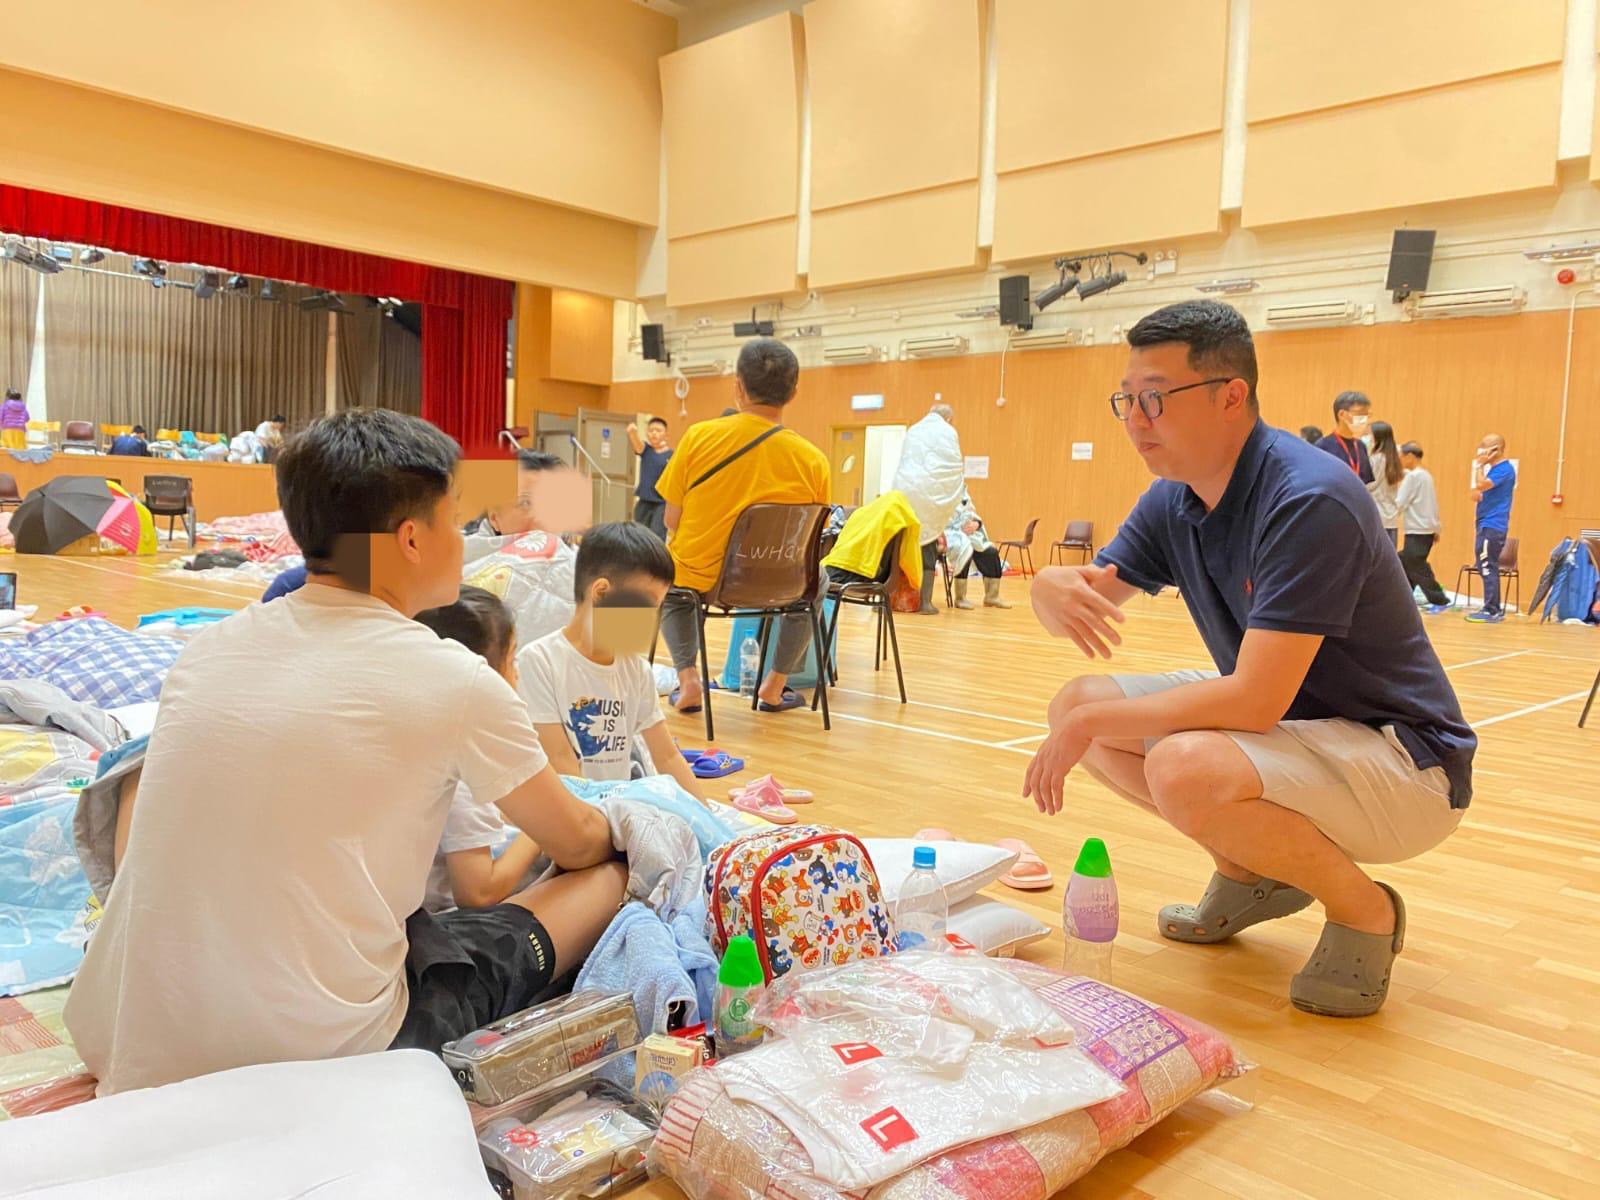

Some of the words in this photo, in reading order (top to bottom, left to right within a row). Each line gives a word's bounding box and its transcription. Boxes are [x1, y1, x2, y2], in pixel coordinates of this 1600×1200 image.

[604, 719, 616, 732] IS
[605, 735, 626, 752] LIFE
[840, 1044, 869, 1059] L
[870, 1113, 899, 1142] L
